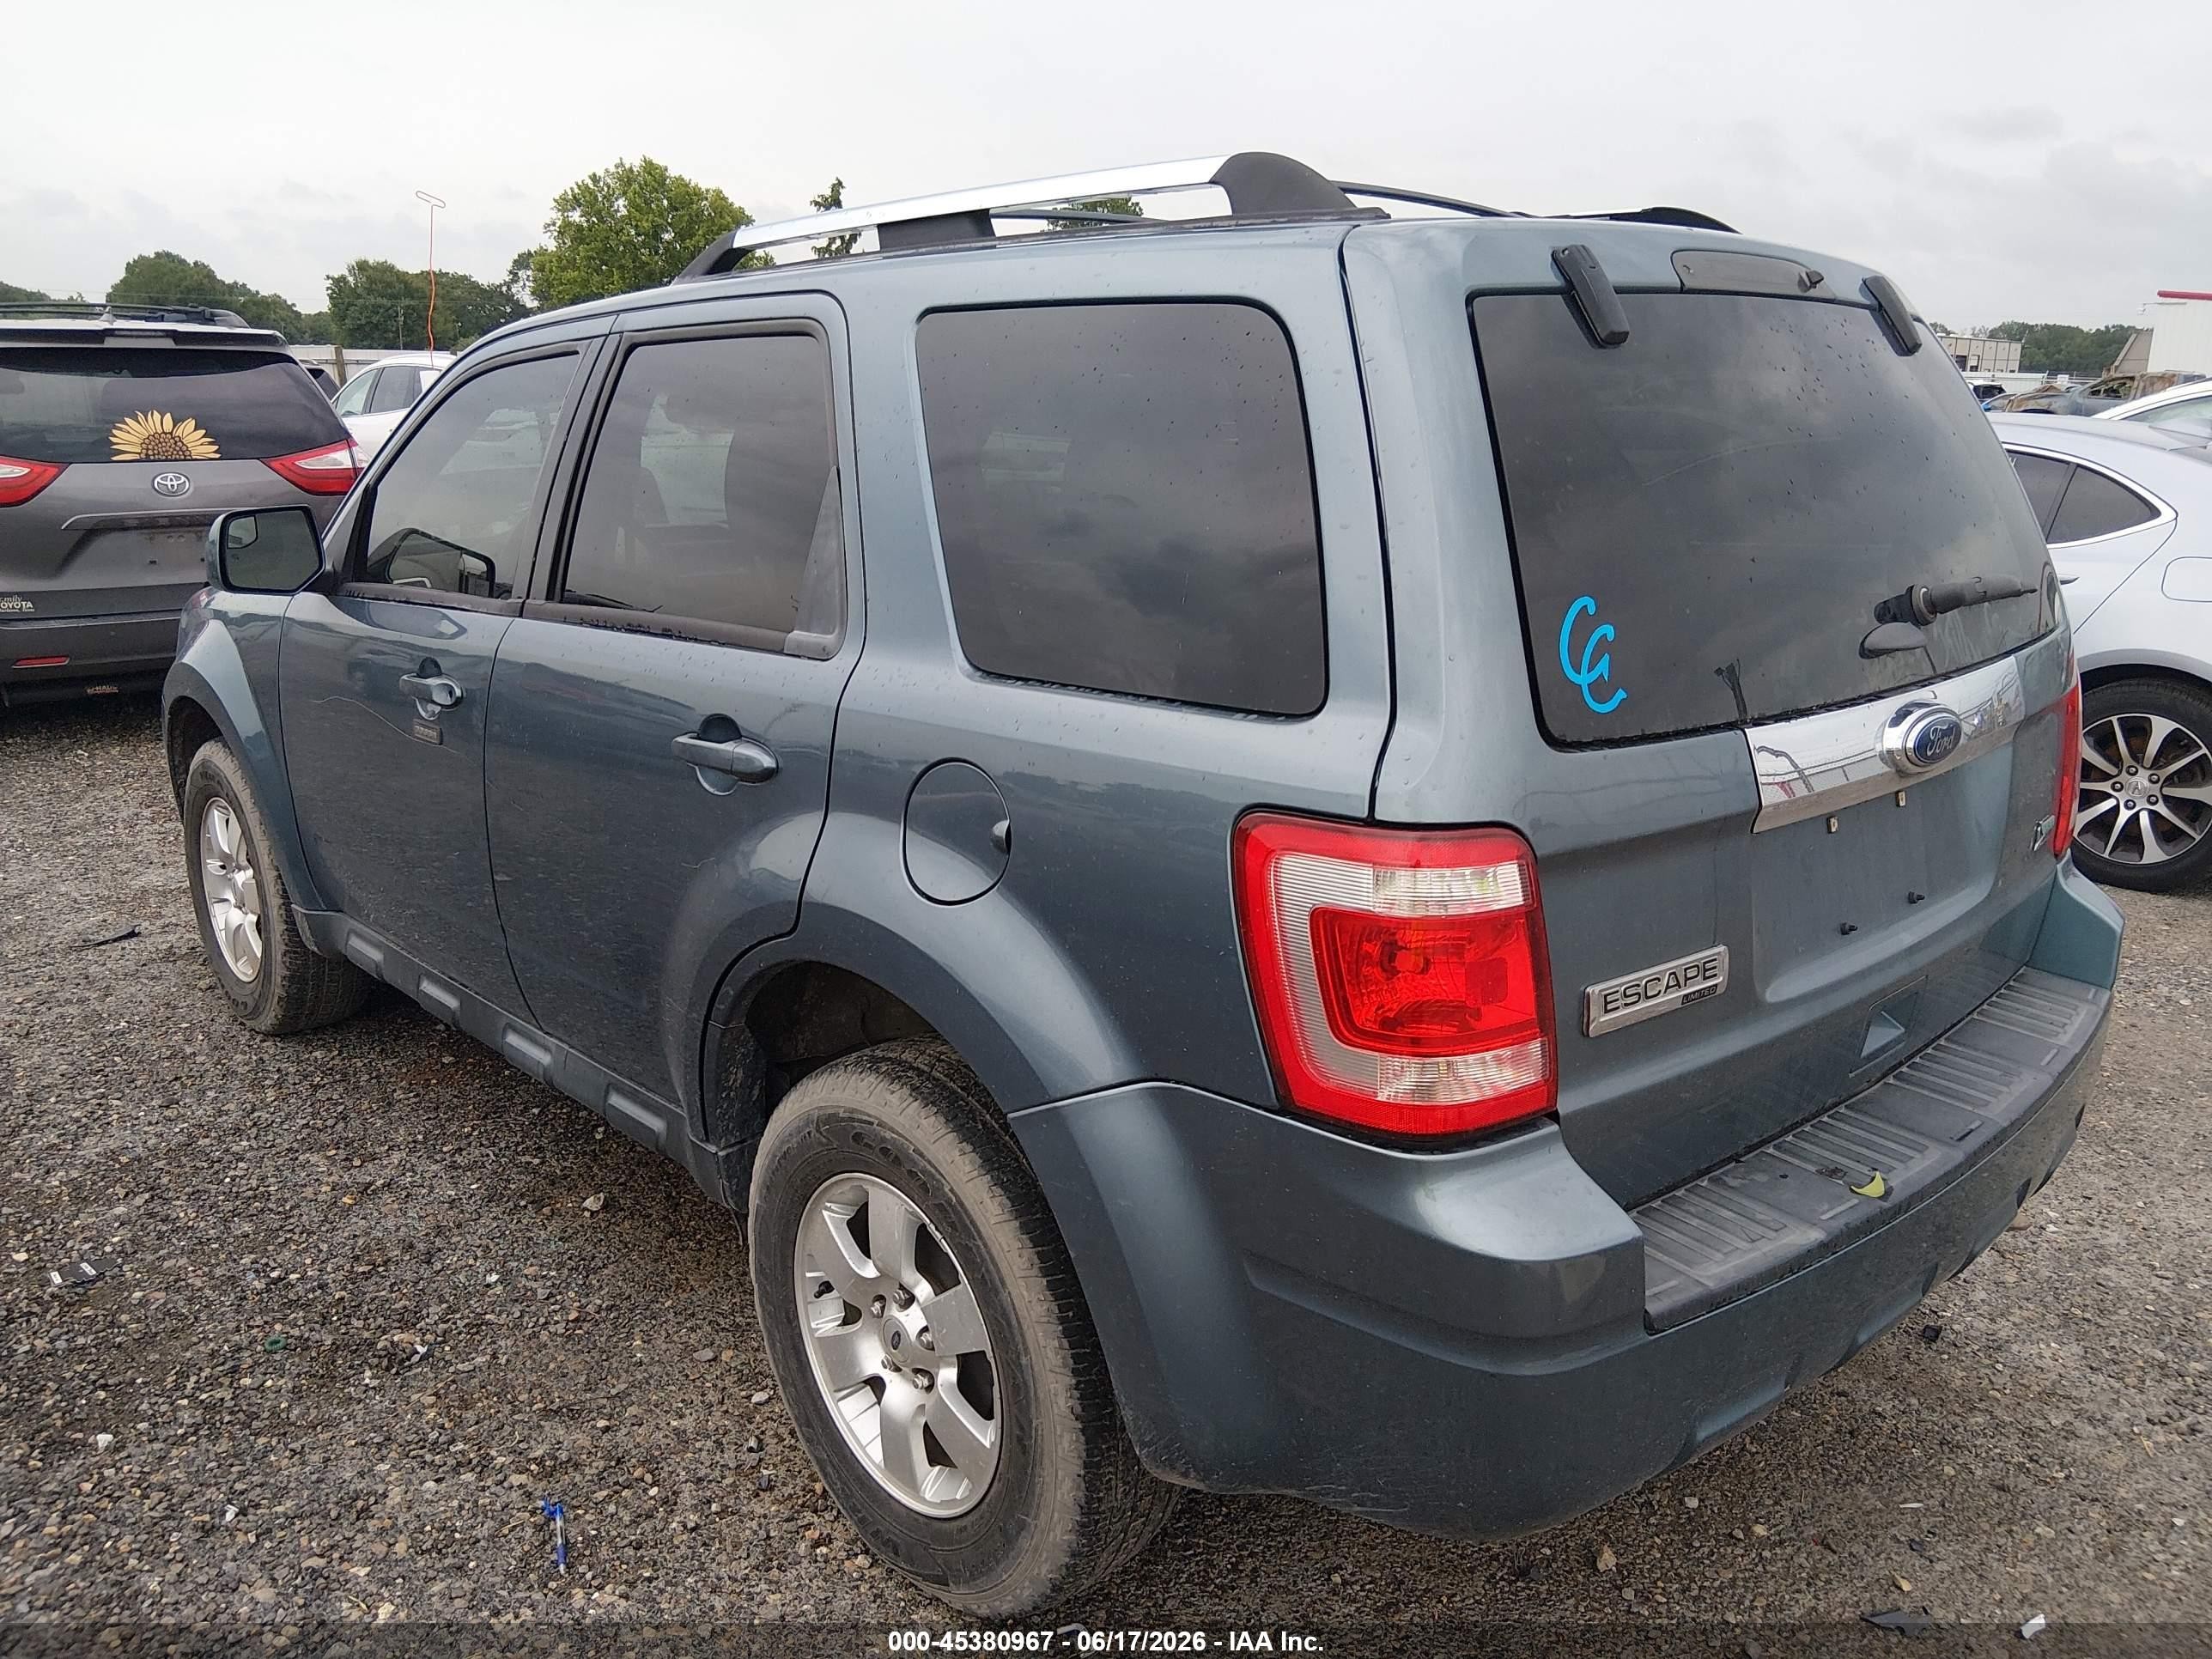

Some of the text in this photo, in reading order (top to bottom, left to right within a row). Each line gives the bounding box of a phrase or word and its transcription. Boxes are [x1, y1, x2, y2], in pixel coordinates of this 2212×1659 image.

[1926, 723, 1956, 757] Ford
[1603, 957, 1718, 1014] ESCAPE
[1682, 986, 1717, 1004] LIMITED
